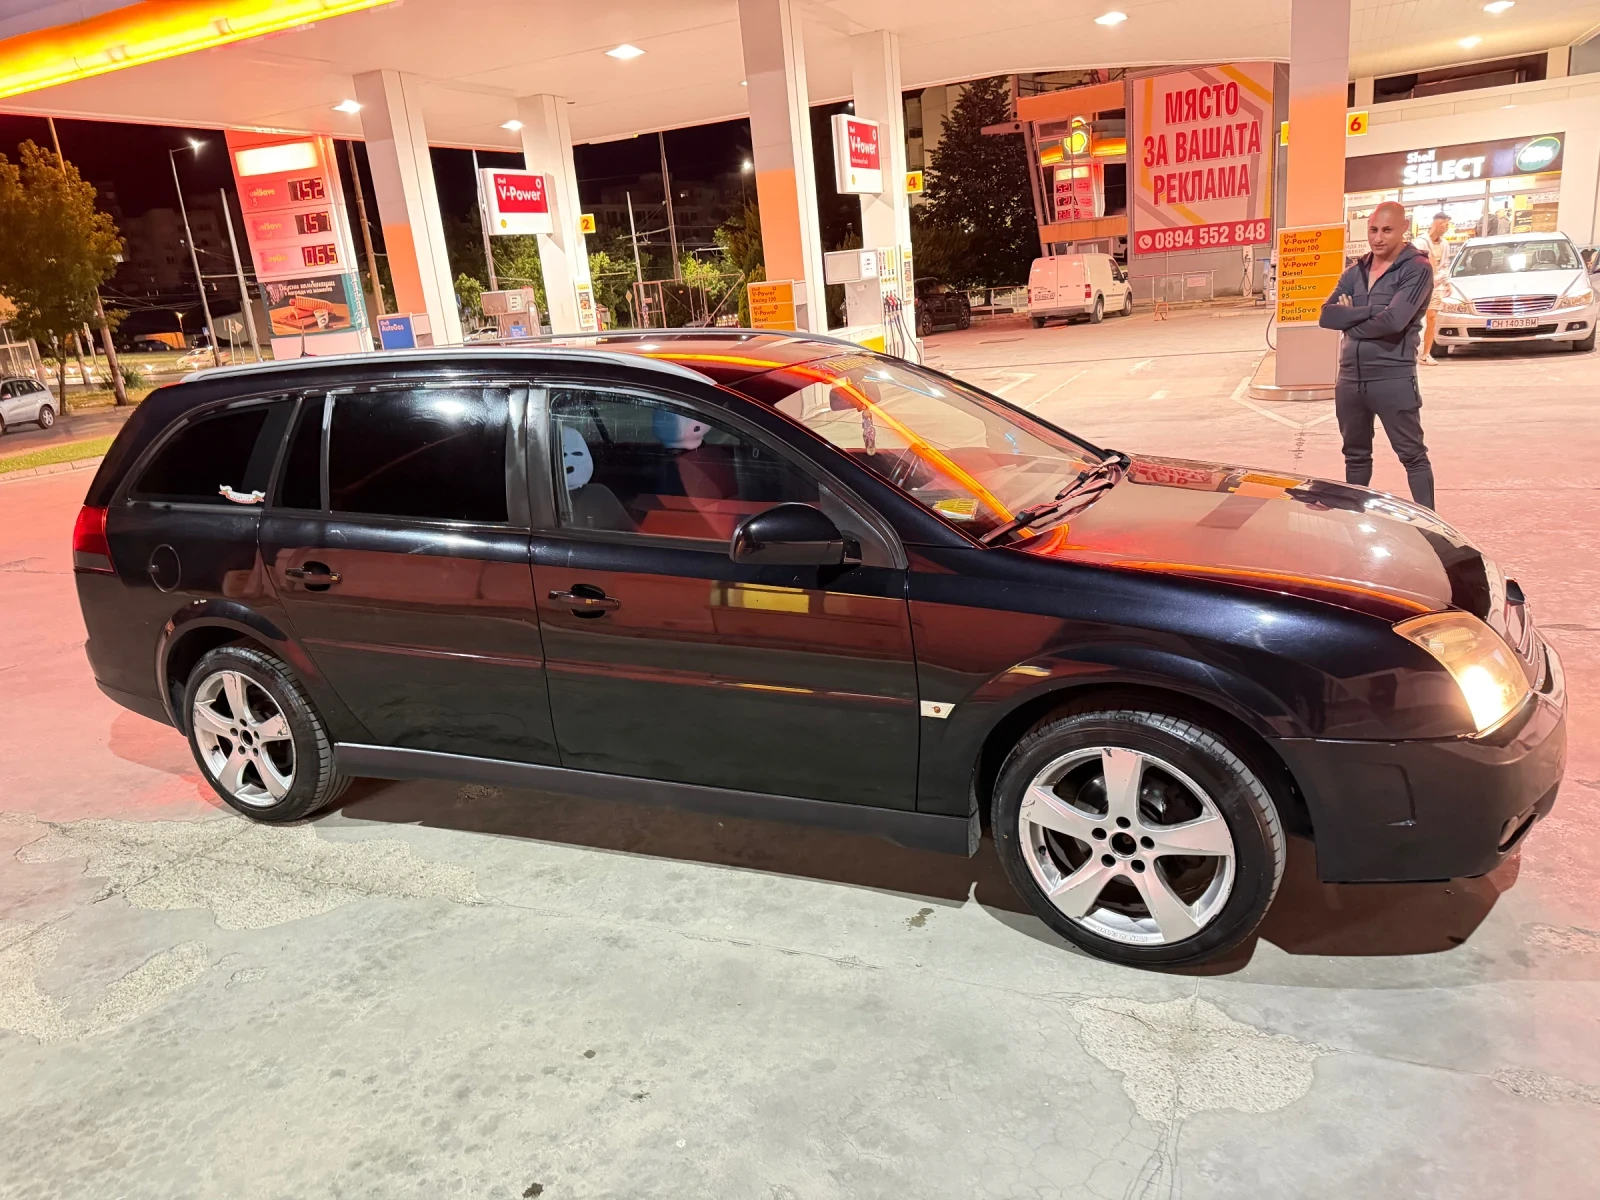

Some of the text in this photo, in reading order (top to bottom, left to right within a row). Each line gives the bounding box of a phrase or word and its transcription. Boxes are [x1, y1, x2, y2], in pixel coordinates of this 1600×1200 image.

[1165, 82, 1239, 125] МЯСТО
[1350, 116, 1362, 132] 6
[850, 136, 876, 155] V-Power
[1144, 120, 1262, 168] ЗА ВАШАТА
[1406, 149, 1436, 164] Shell
[1402, 156, 1487, 186] SELECT
[908, 176, 918, 189] 4
[1153, 164, 1251, 206] РЕКЛАМА
[498, 186, 541, 202] V-Power
[582, 218, 590, 231] 2
[1154, 222, 1266, 250] 0894 552 848
[1283, 237, 1318, 246] V-Power
[1282, 284, 1317, 292] FuelSave
[1281, 307, 1317, 315] FuelSave
[382, 324, 405, 332] AutoGas
[1492, 318, 1537, 328] CH 1403 BM
